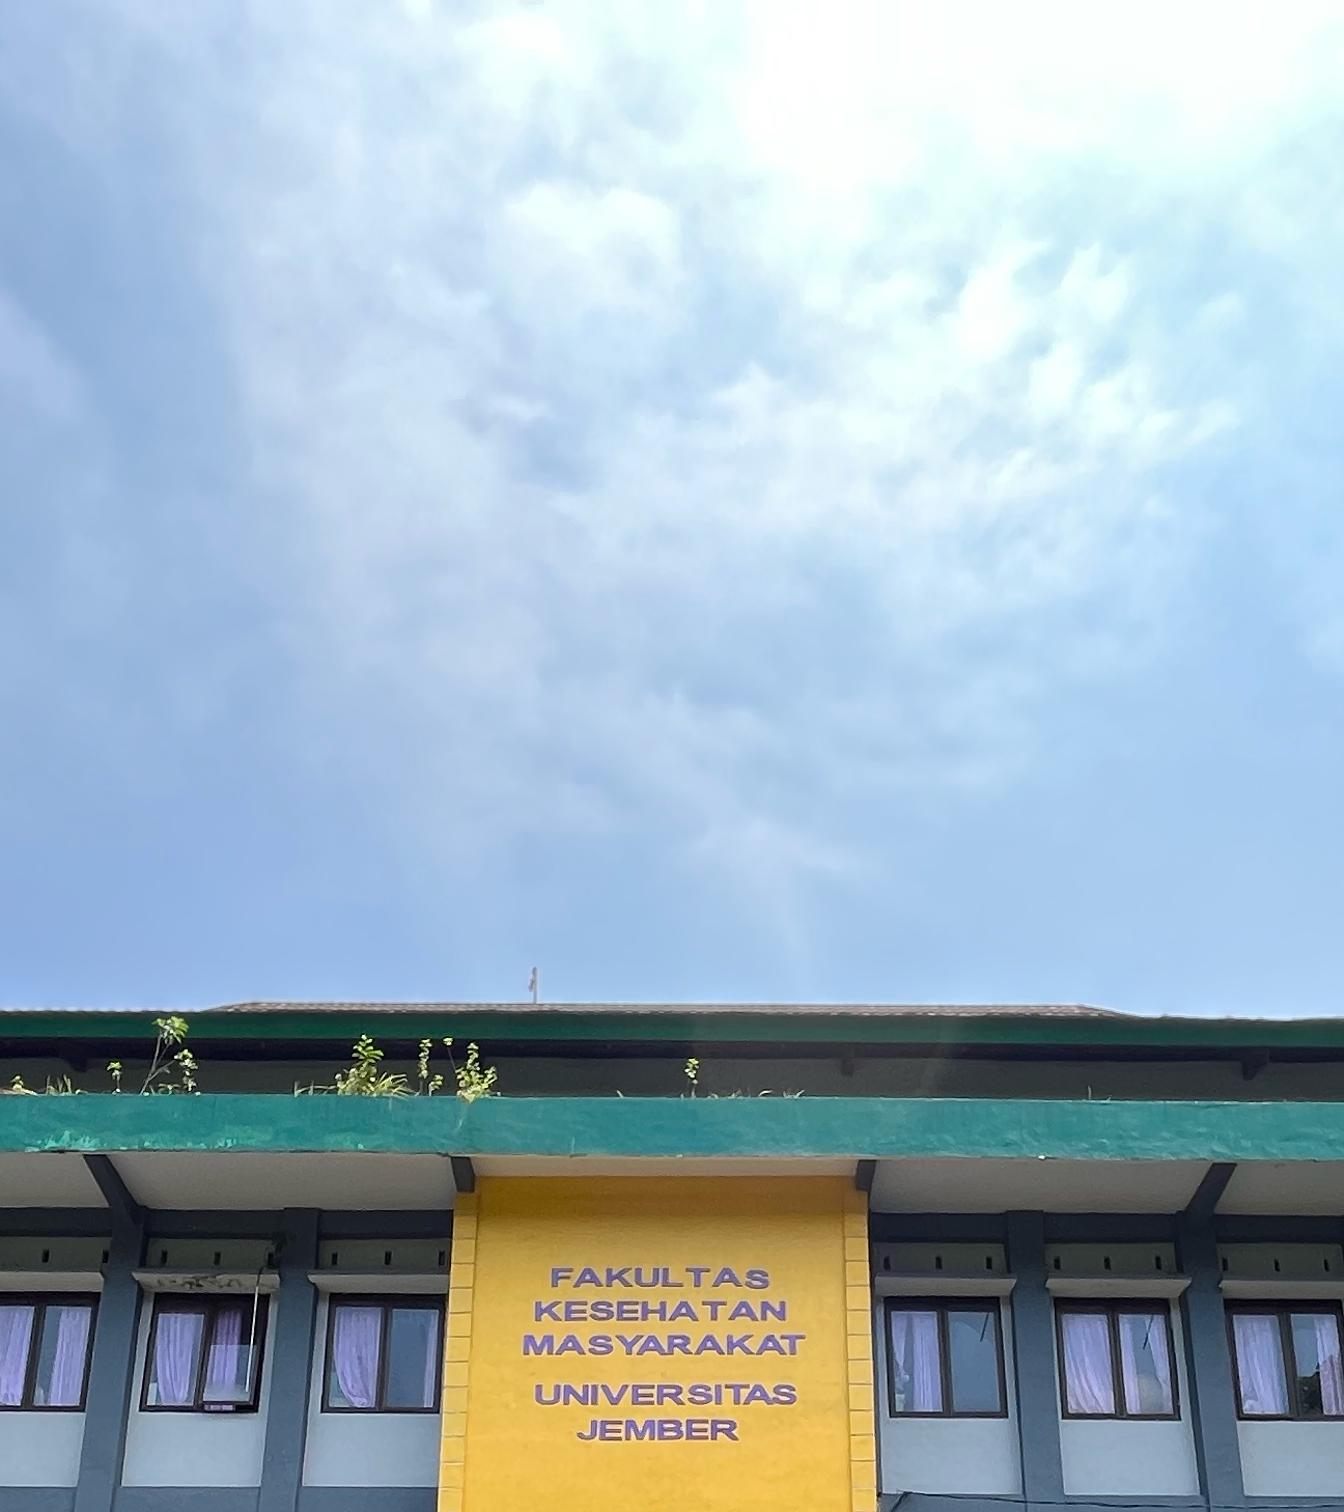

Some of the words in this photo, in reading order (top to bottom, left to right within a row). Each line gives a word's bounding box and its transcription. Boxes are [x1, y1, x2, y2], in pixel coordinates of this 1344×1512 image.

[550, 1266, 770, 1289] FAKULTAS
[534, 1299, 788, 1322] KESEHATAN
[522, 1333, 806, 1356] MASYARAKAT
[534, 1383, 798, 1407] UNIVERSITAS
[576, 1418, 739, 1442] JEMBER
